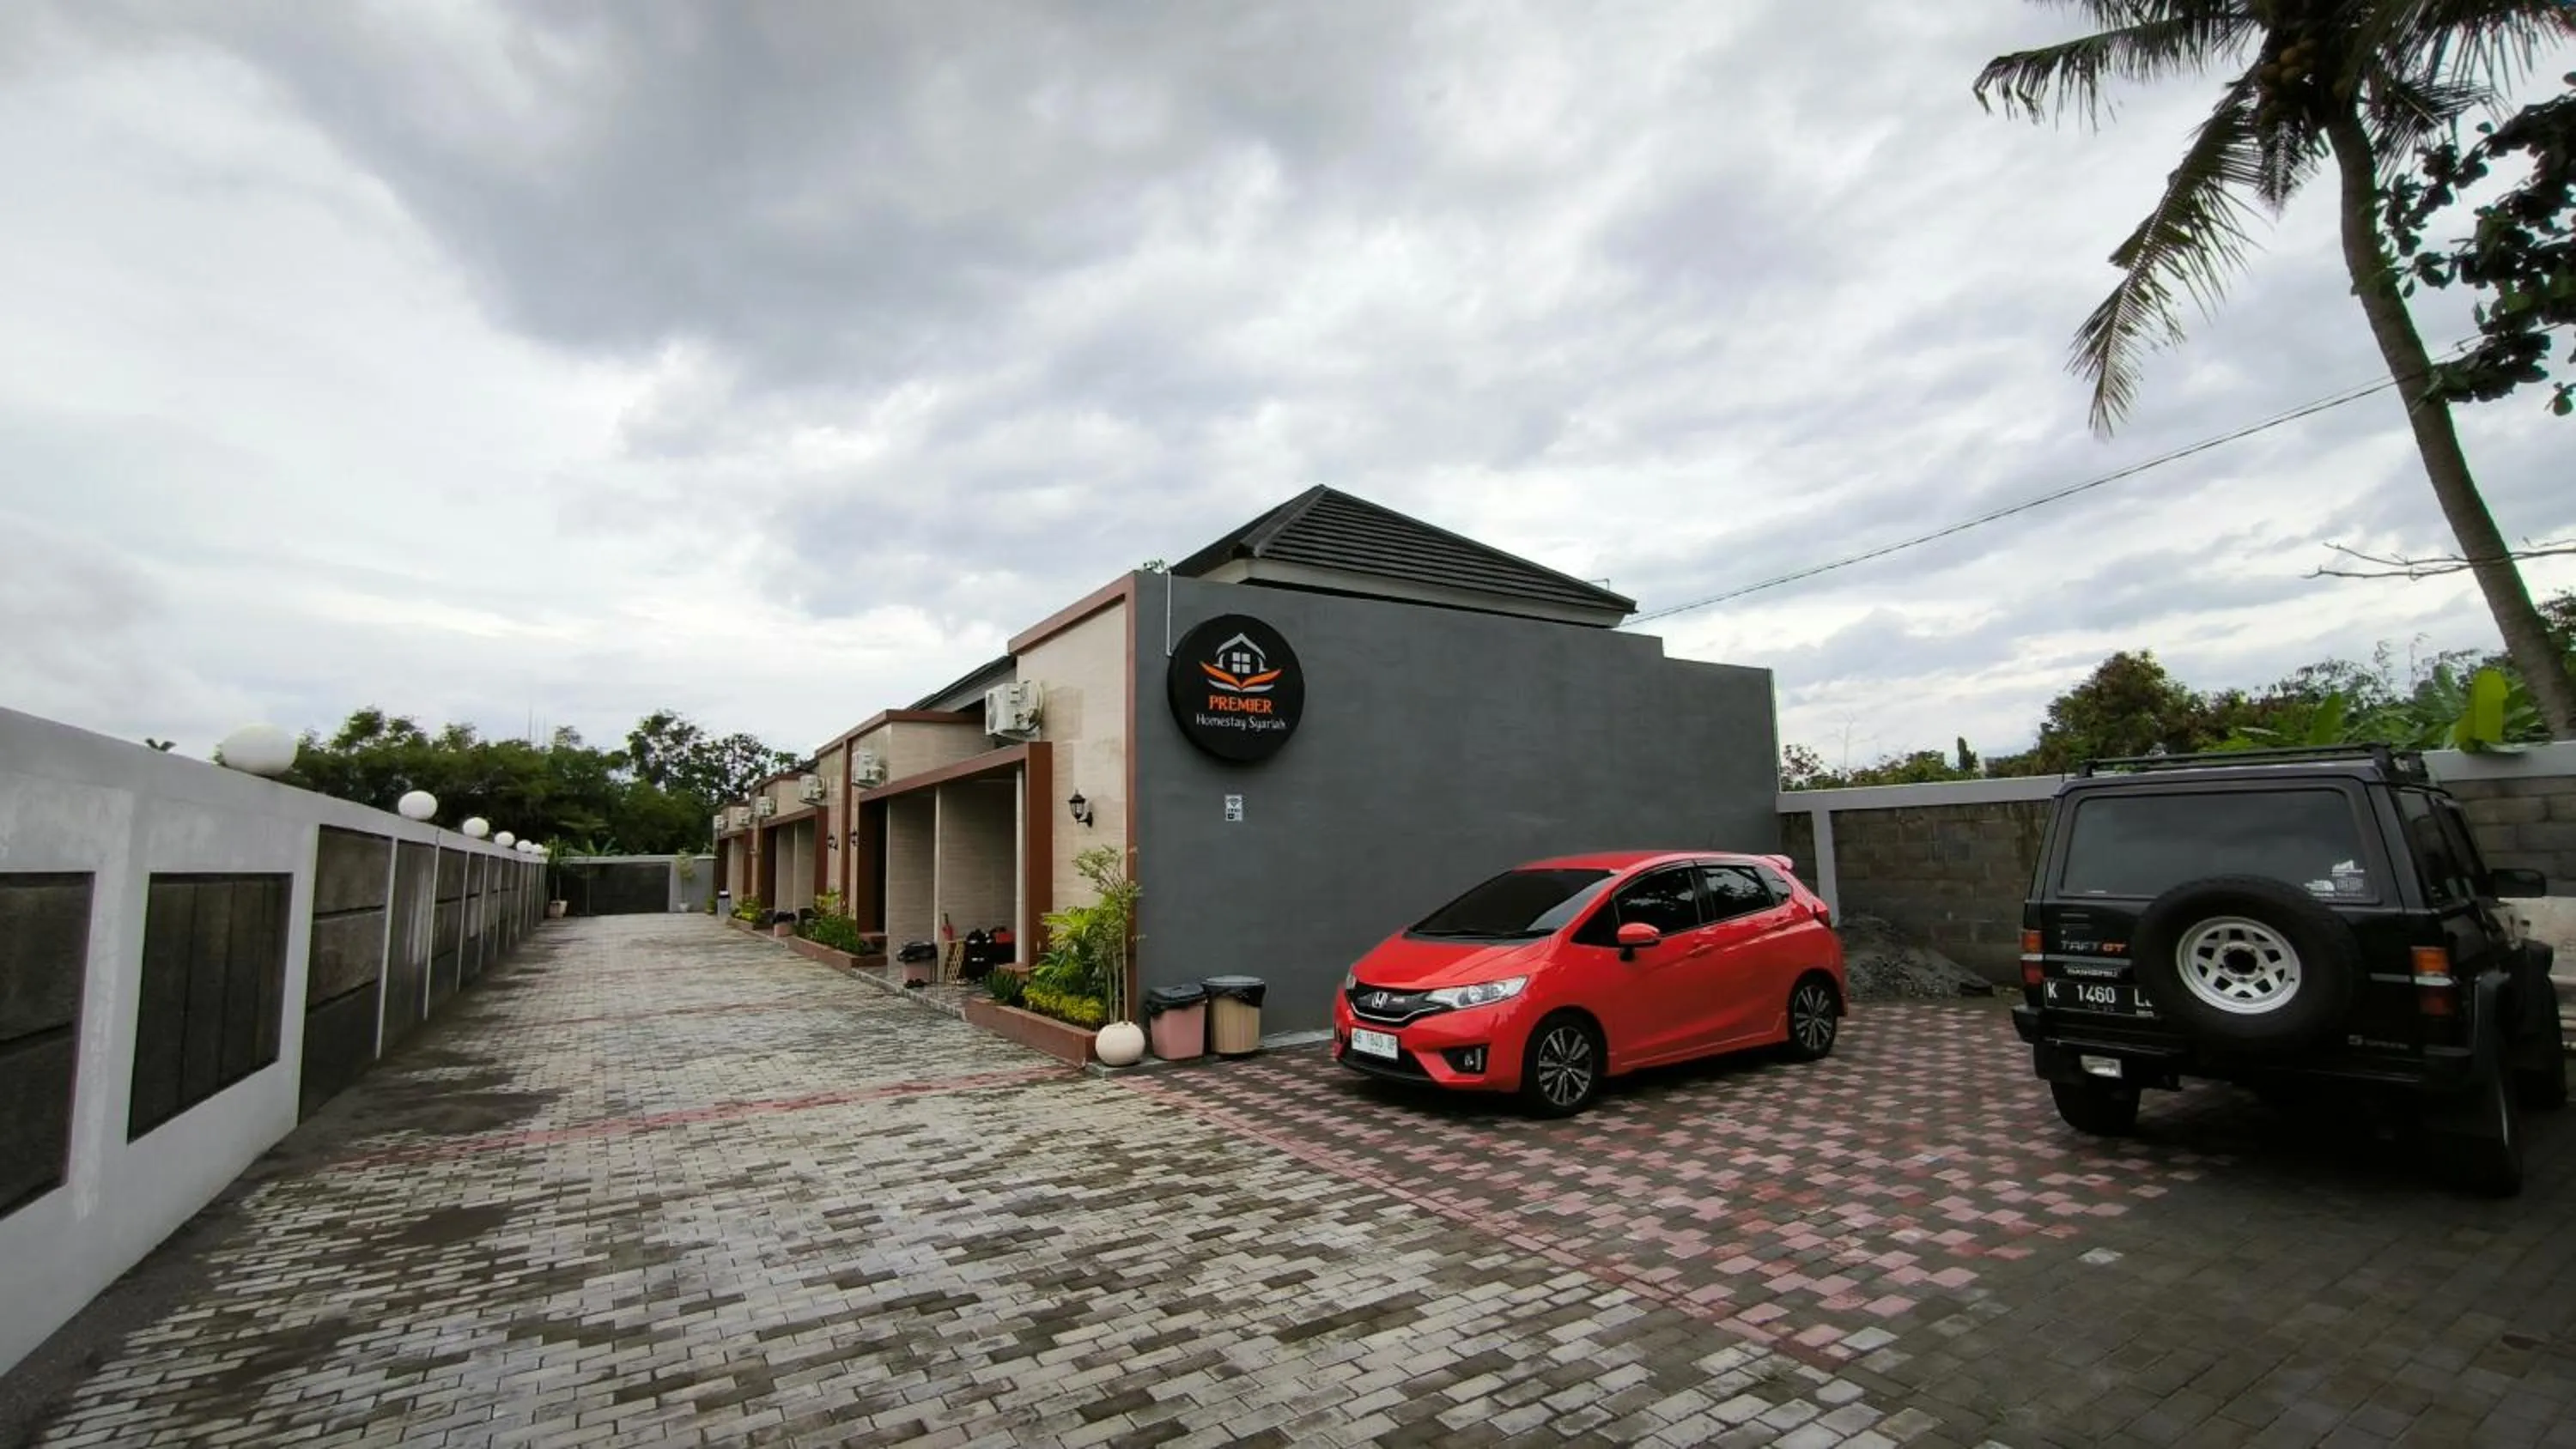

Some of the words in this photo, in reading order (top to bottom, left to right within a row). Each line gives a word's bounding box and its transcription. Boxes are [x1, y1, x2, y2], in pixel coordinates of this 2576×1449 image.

[1209, 695, 1273, 714] PREMIER
[1196, 713, 1246, 731] Homestay
[1249, 716, 1286, 731] Syariah
[2047, 982, 2058, 998] K
[2077, 984, 2117, 1003] 1460
